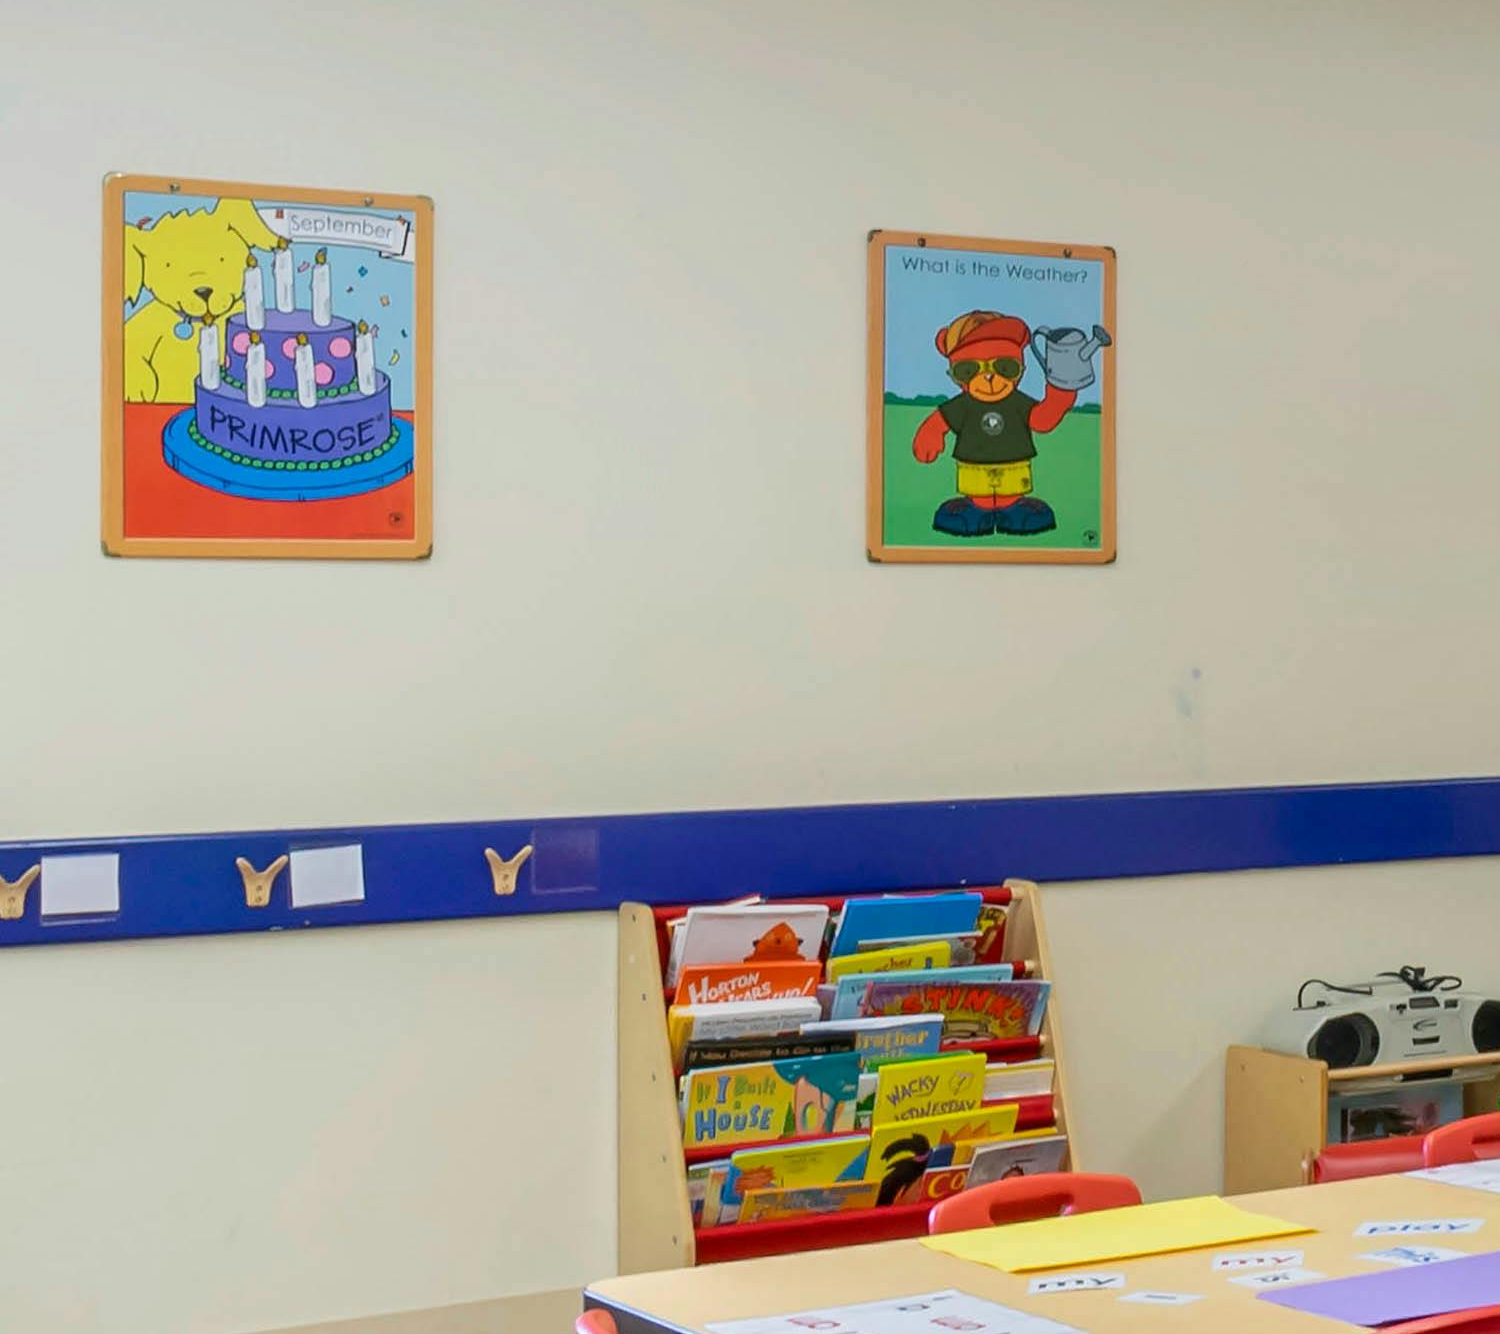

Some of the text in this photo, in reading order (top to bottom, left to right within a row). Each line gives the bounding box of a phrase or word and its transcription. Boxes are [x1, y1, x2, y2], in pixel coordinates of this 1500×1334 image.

[289, 214, 394, 243] September
[902, 256, 1088, 284] What is the Weather?
[886, 1074, 940, 1107] WACKY
[1036, 1275, 1120, 1290] my
